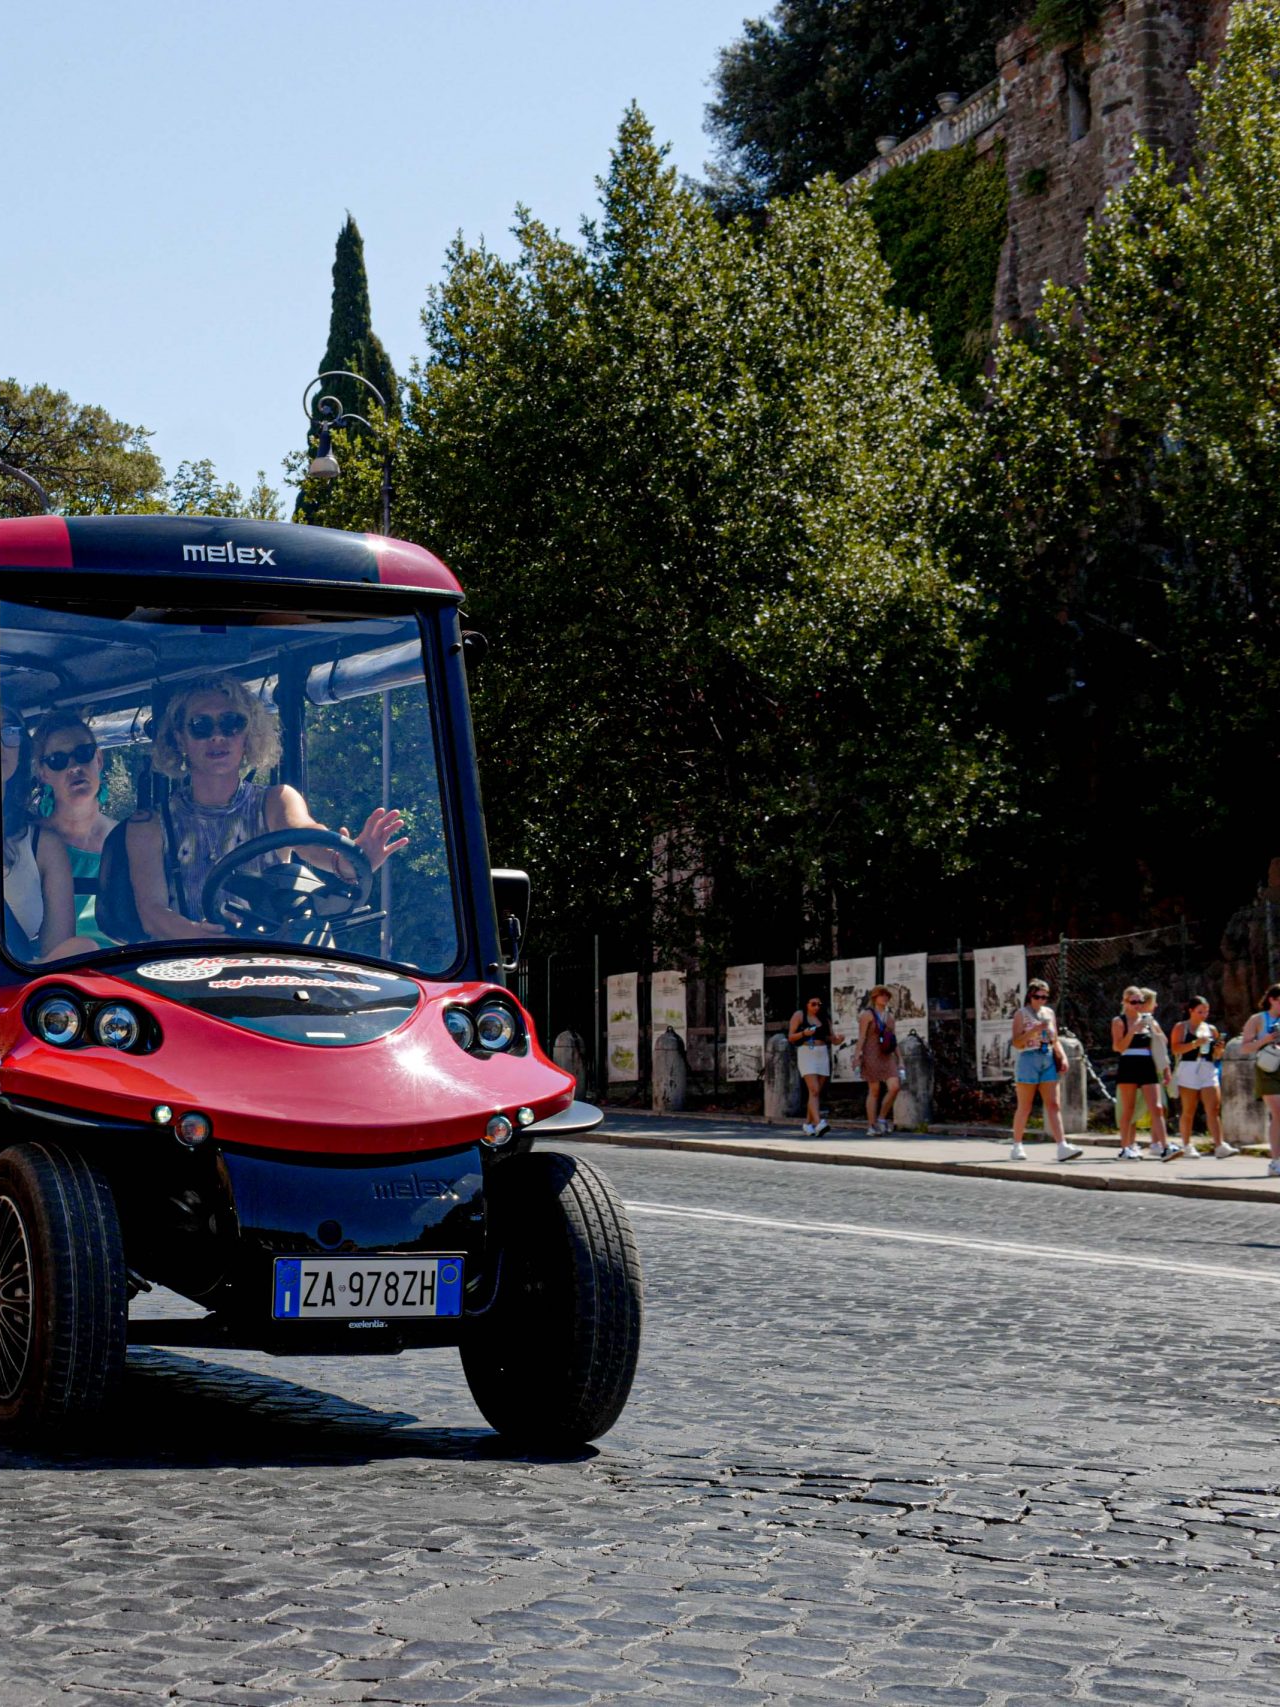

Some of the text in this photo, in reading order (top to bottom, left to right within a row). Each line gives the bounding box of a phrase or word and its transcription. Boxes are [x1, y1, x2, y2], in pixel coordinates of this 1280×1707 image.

[182, 541, 277, 566] melex
[372, 1172, 457, 1200] melex
[303, 1271, 336, 1307] ZA
[349, 1270, 436, 1306] 978ZH
